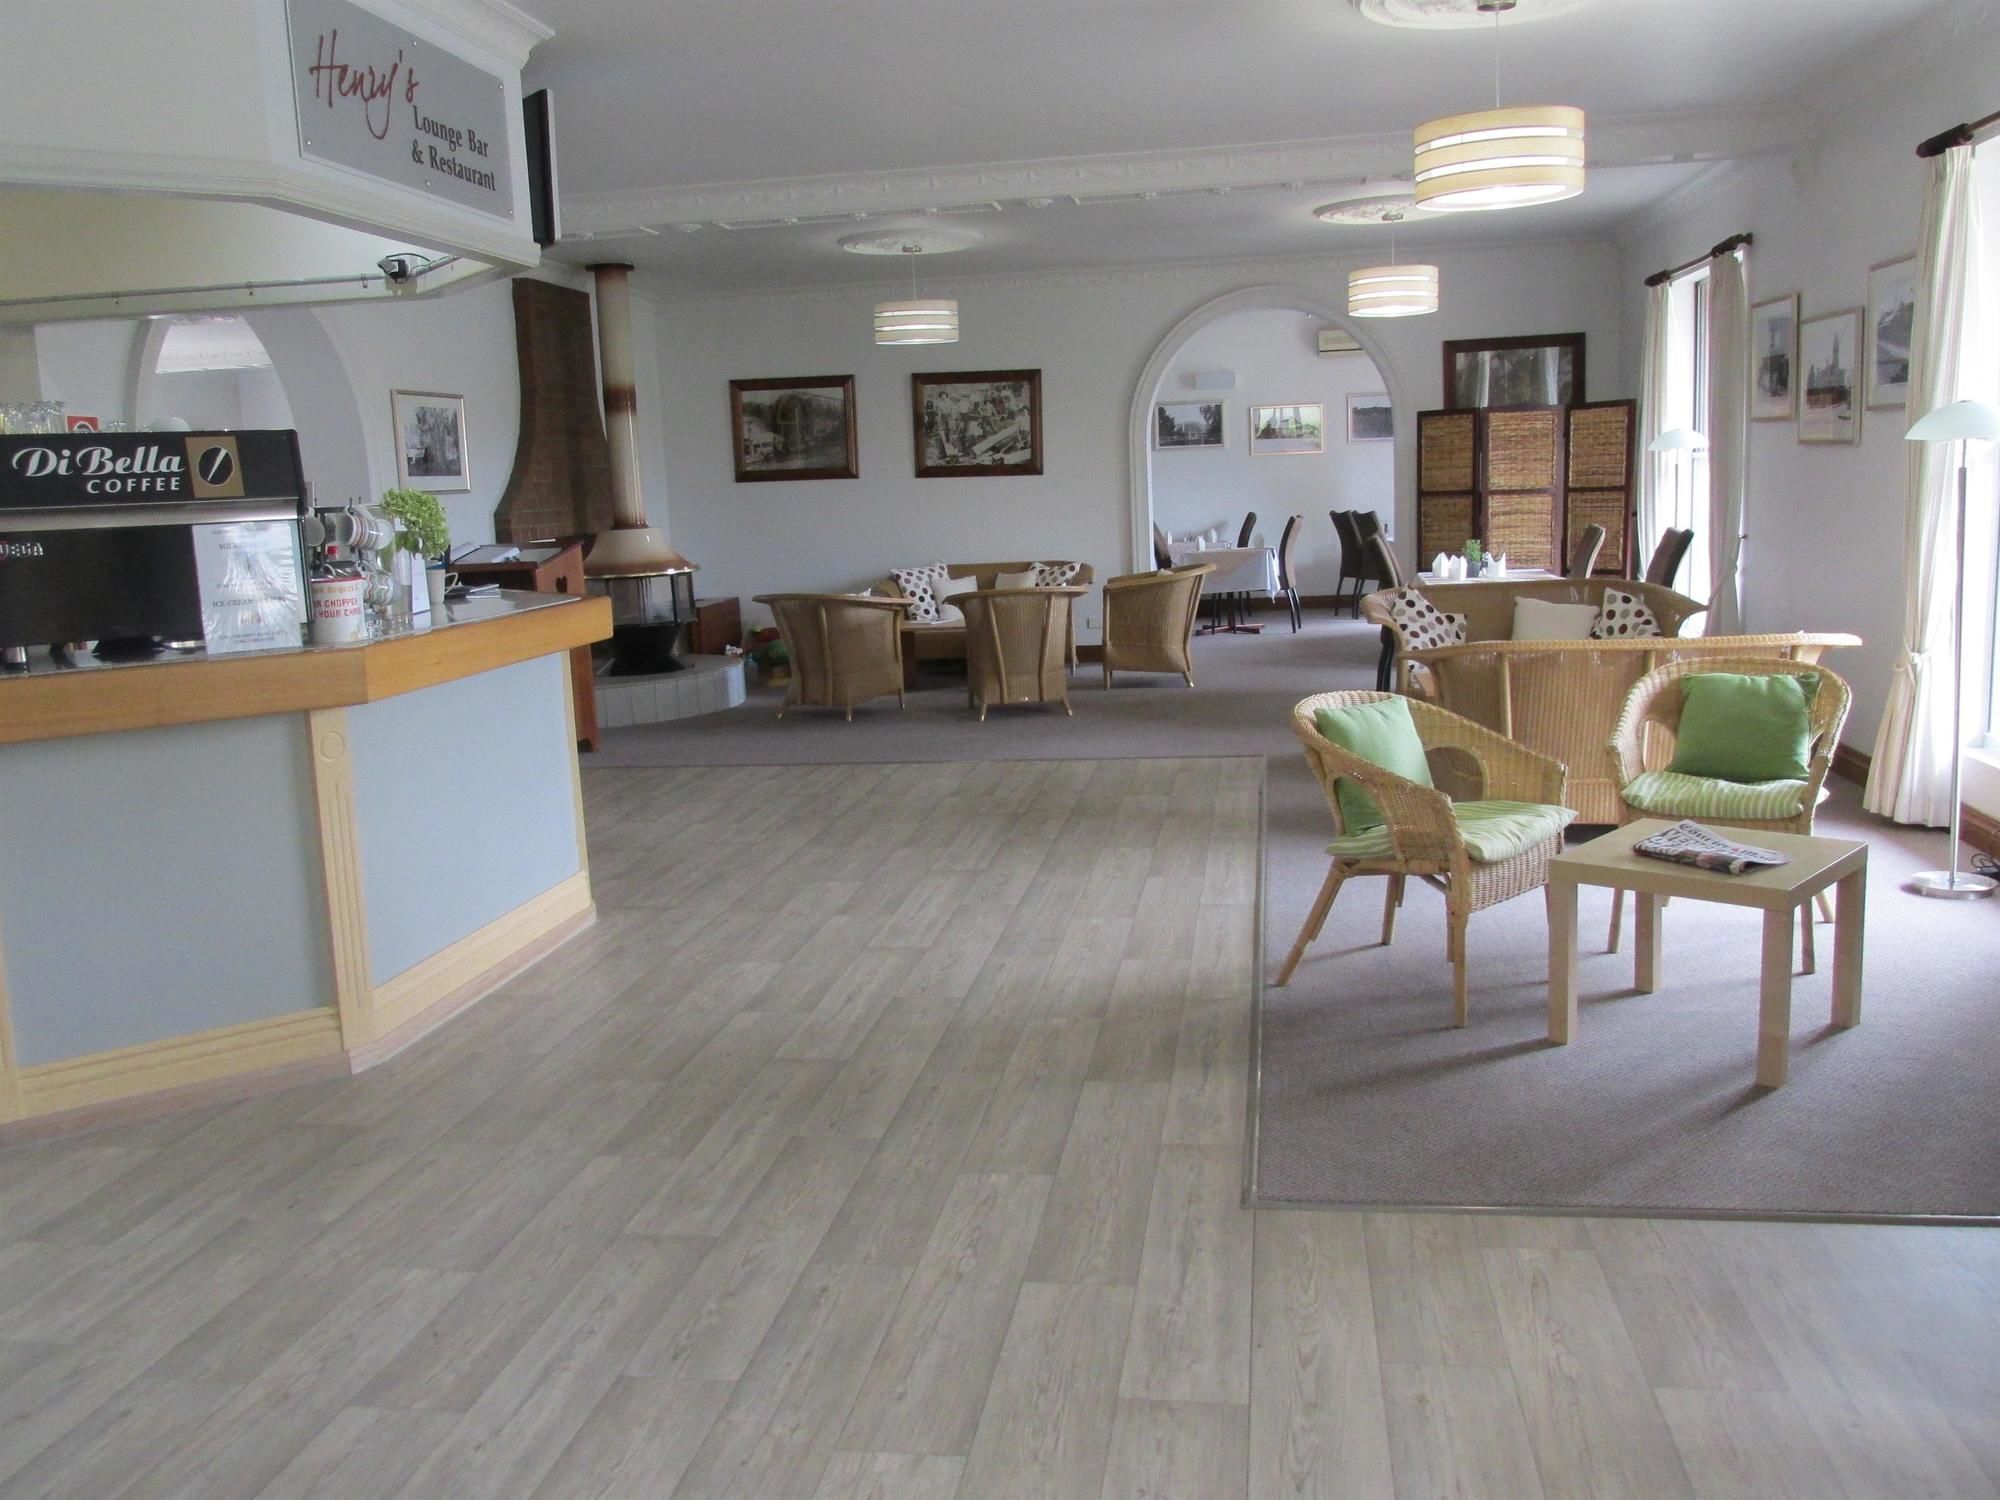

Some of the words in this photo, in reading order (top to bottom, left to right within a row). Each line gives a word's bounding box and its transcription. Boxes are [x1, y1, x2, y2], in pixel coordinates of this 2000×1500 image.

[308, 28, 420, 140] Henry's
[412, 104, 463, 152] Lounge
[467, 128, 489, 158] Bar
[411, 138, 425, 165] &
[428, 144, 496, 192] Restaurant
[11, 447, 74, 477] Di
[76, 445, 186, 476] Bella
[86, 476, 180, 494] COFFEE
